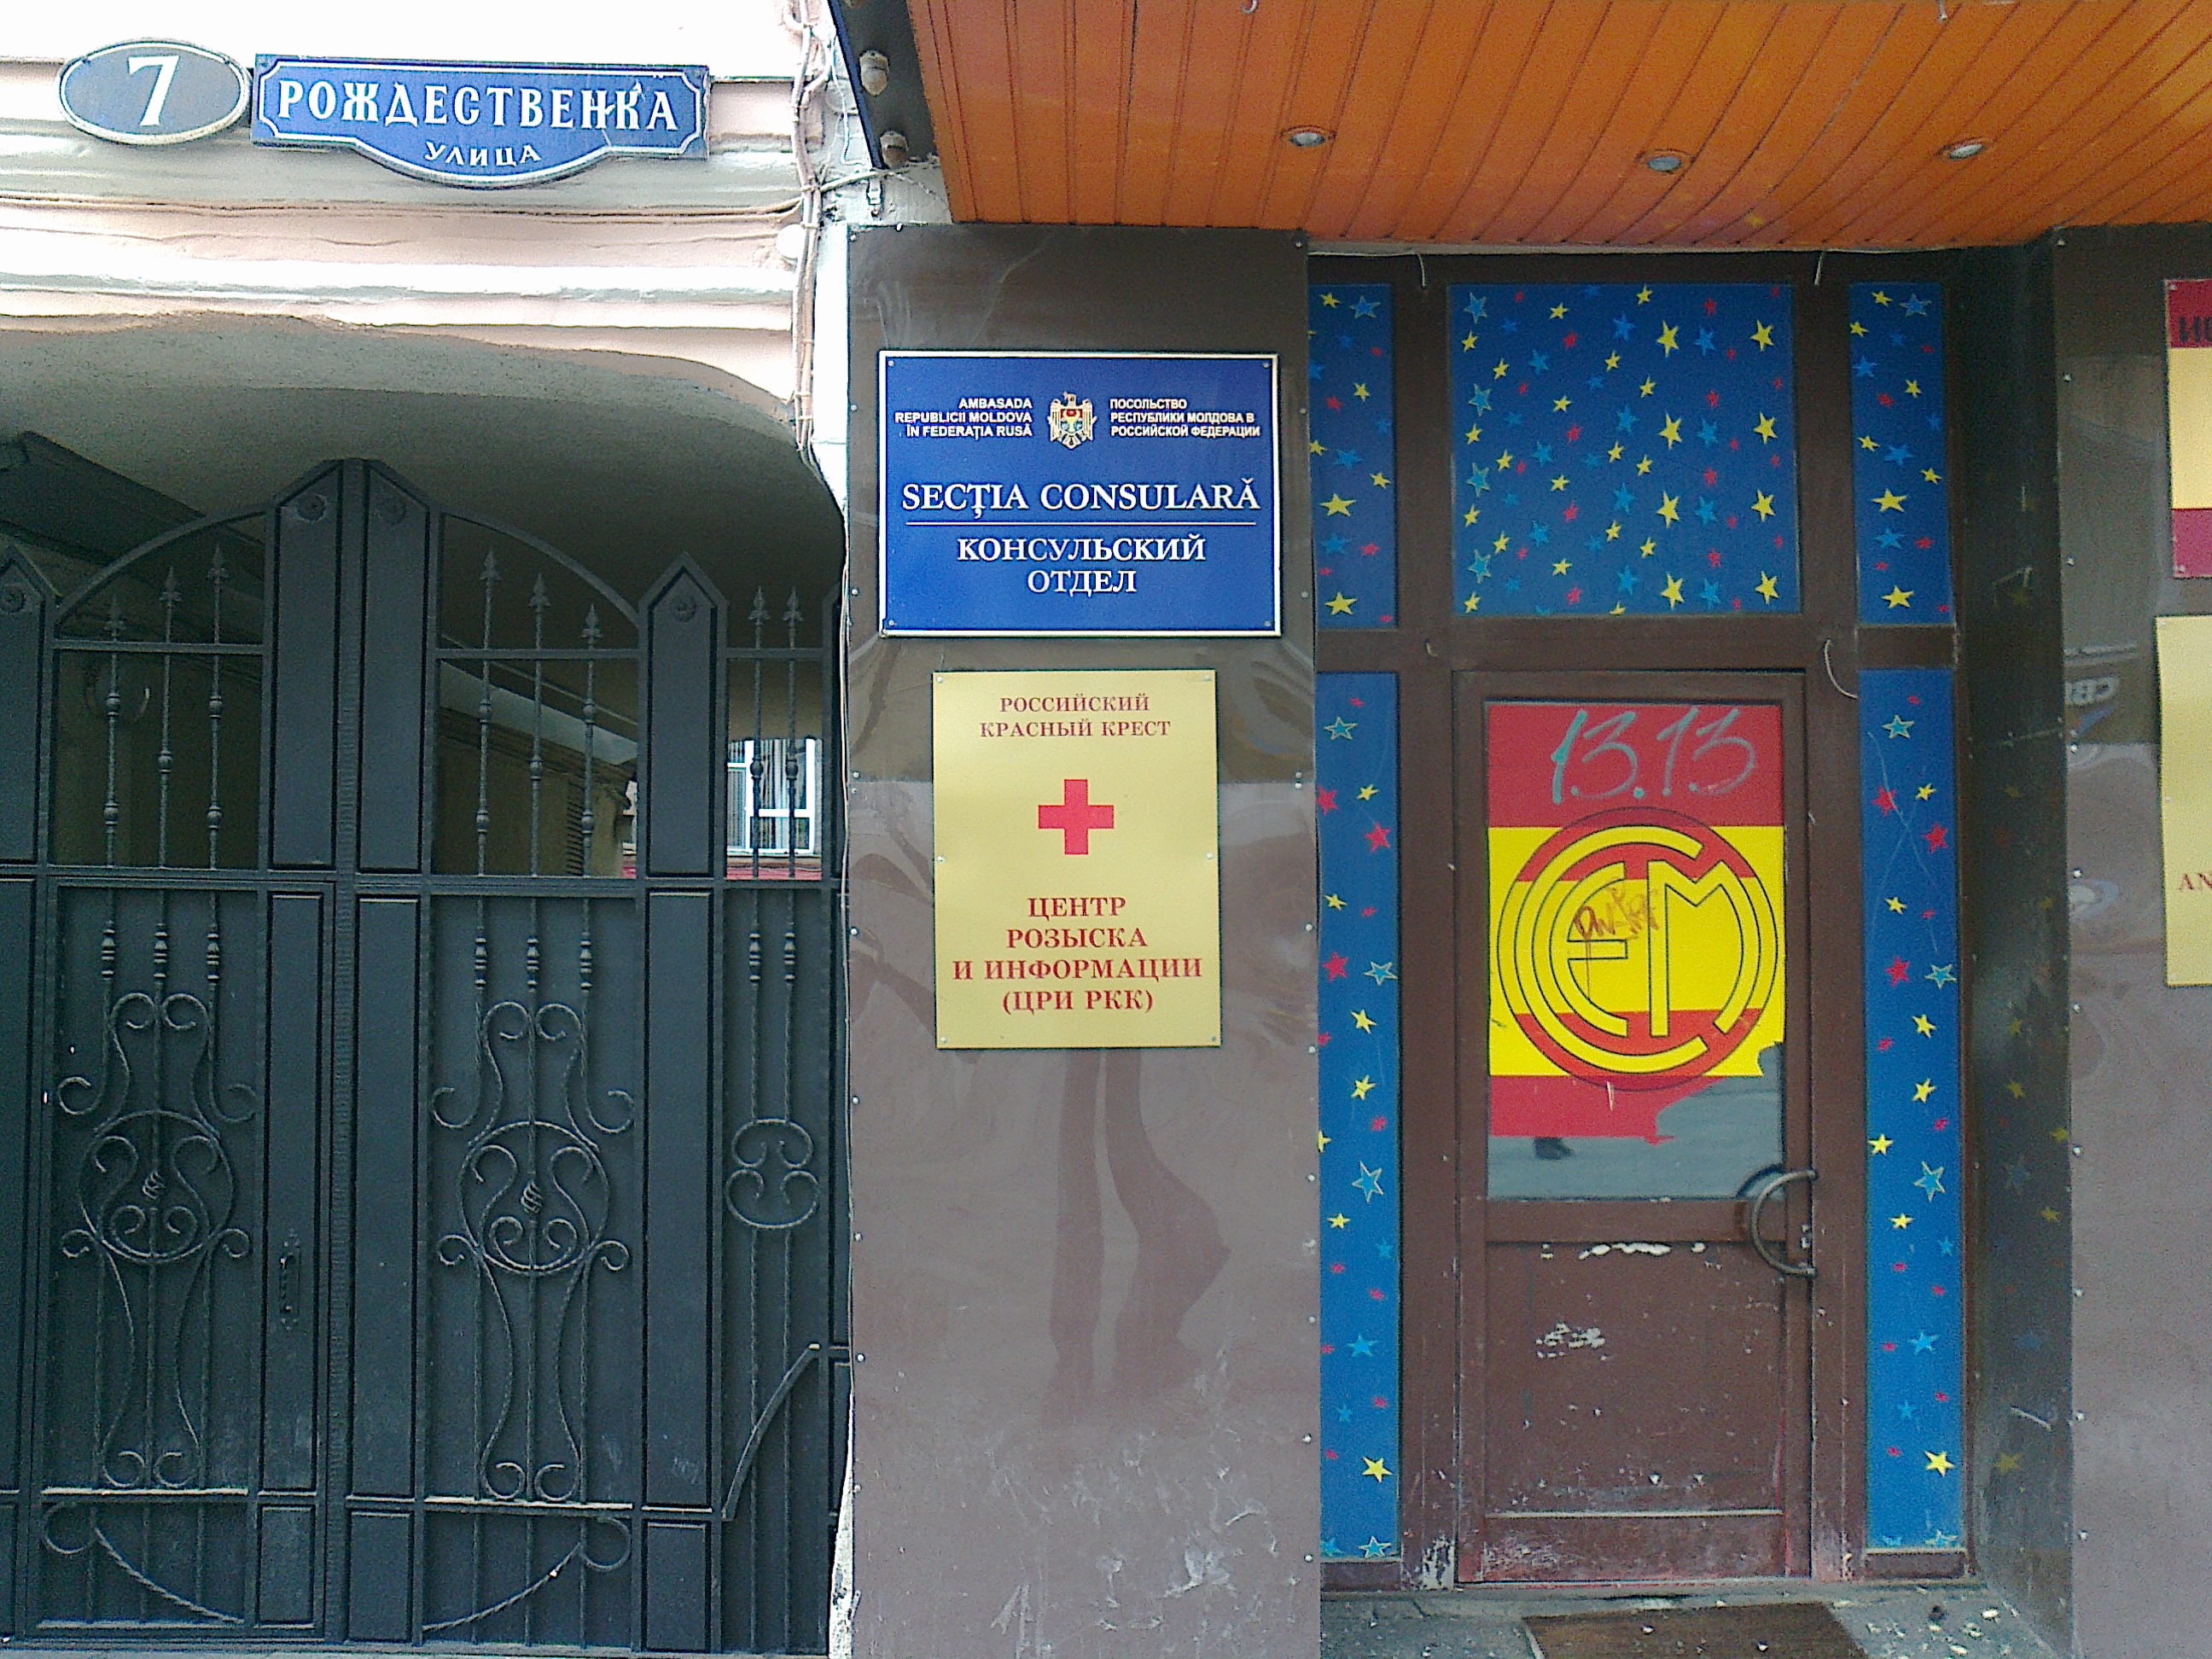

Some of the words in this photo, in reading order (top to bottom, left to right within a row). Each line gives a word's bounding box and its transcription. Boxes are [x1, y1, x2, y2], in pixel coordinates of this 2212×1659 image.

[127, 55, 179, 127] 7
[276, 80, 680, 132] РОЖДЕСТВЕНКА
[423, 142, 542, 166] УЛИЦА
[958, 397, 1033, 410] AMBASADA
[1109, 399, 1187, 410] ПОСОЛЬСТВО
[895, 411, 965, 423] REPUBLICII
[969, 411, 1033, 423] MOLDOVA
[1110, 412, 1183, 424] РЕСПУБЛИКИ
[1186, 412, 1244, 425] МОЛДОВА
[1246, 413, 1255, 423] В
[906, 423, 920, 437] ÎN
[1111, 424, 1188, 438] РОССИЙСКОЙ
[1190, 425, 1260, 439] ФЕДЕРАЦИИ
[1040, 478, 1260, 510] CONSULARĂ
[957, 534, 1206, 562] КОНСУЛЬСКИЙ
[1027, 570, 1137, 597] ОТДЕЛ
[999, 693, 1150, 713] РОССИЙСКИЙ
[981, 719, 1092, 737] КРАСНЫЙ
[1102, 720, 1171, 736] КРЕСТ
[1027, 897, 1126, 921] ЦЕНТР
[1007, 928, 1148, 949] РОЗЫСКА
[953, 961, 973, 981] И
[984, 958, 1202, 982] ИНФОРМАЦИИ
[1002, 991, 1073, 1015] (ЦРИ
[1085, 989, 1154, 1013] РКК)
